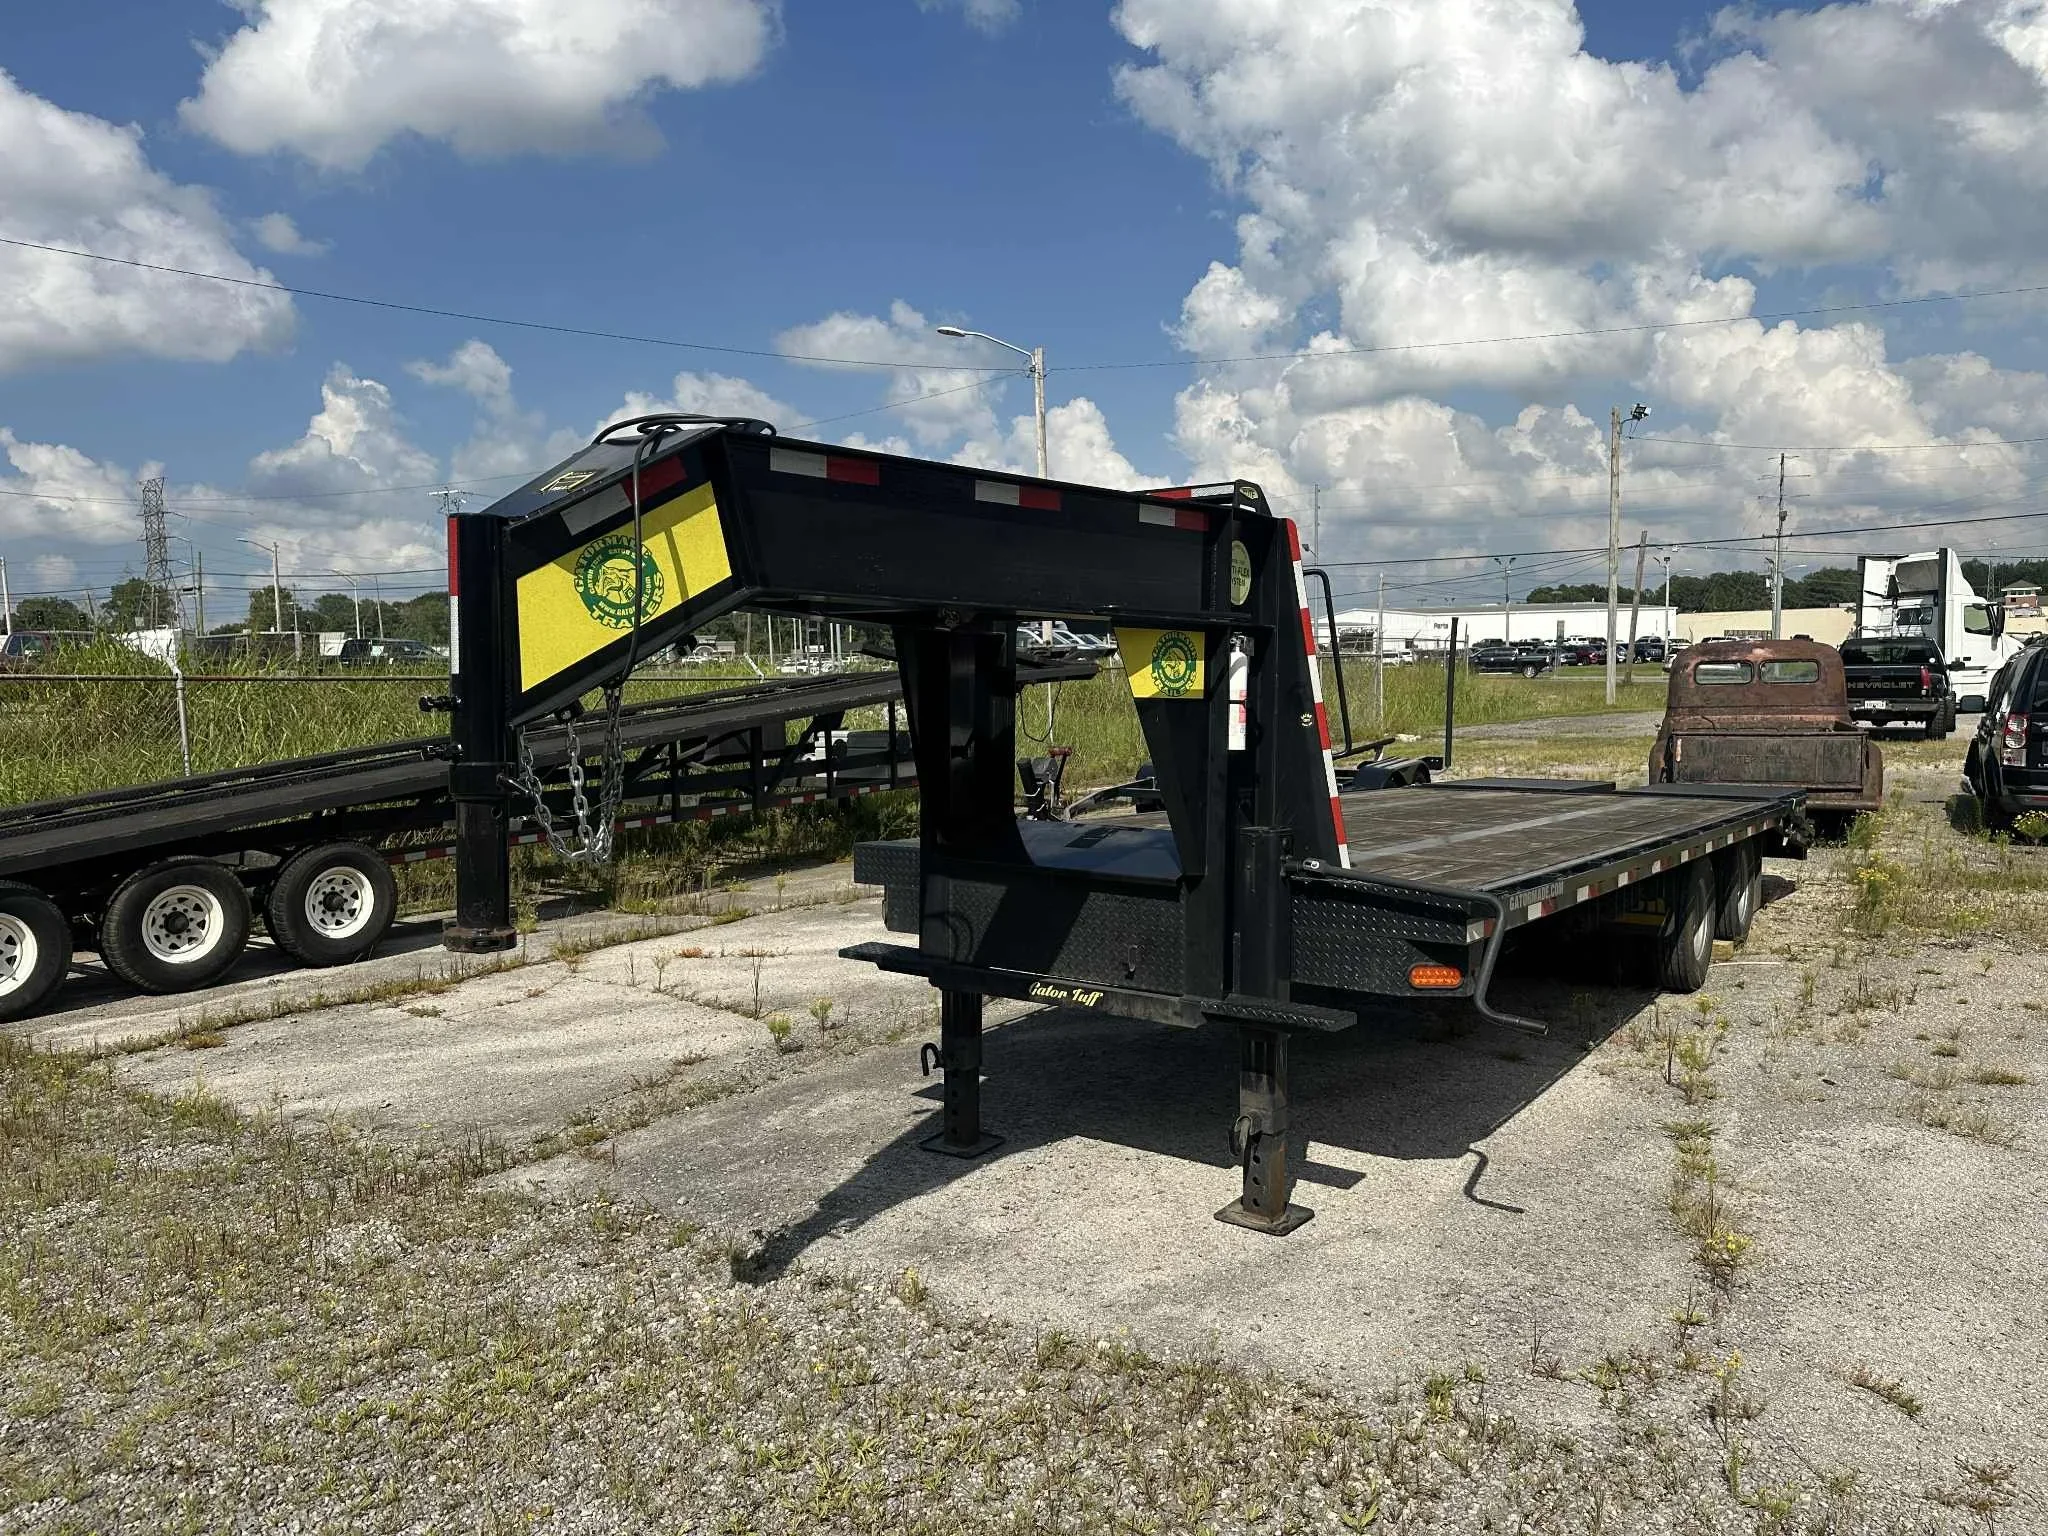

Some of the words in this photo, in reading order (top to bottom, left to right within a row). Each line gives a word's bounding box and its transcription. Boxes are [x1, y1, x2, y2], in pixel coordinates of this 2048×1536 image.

[1847, 681, 1915, 689] HEVROLET
[1509, 879, 1564, 911] GATORMADE.COM
[1029, 981, 1068, 999] Gator
[1071, 988, 1104, 1007] Tuff
